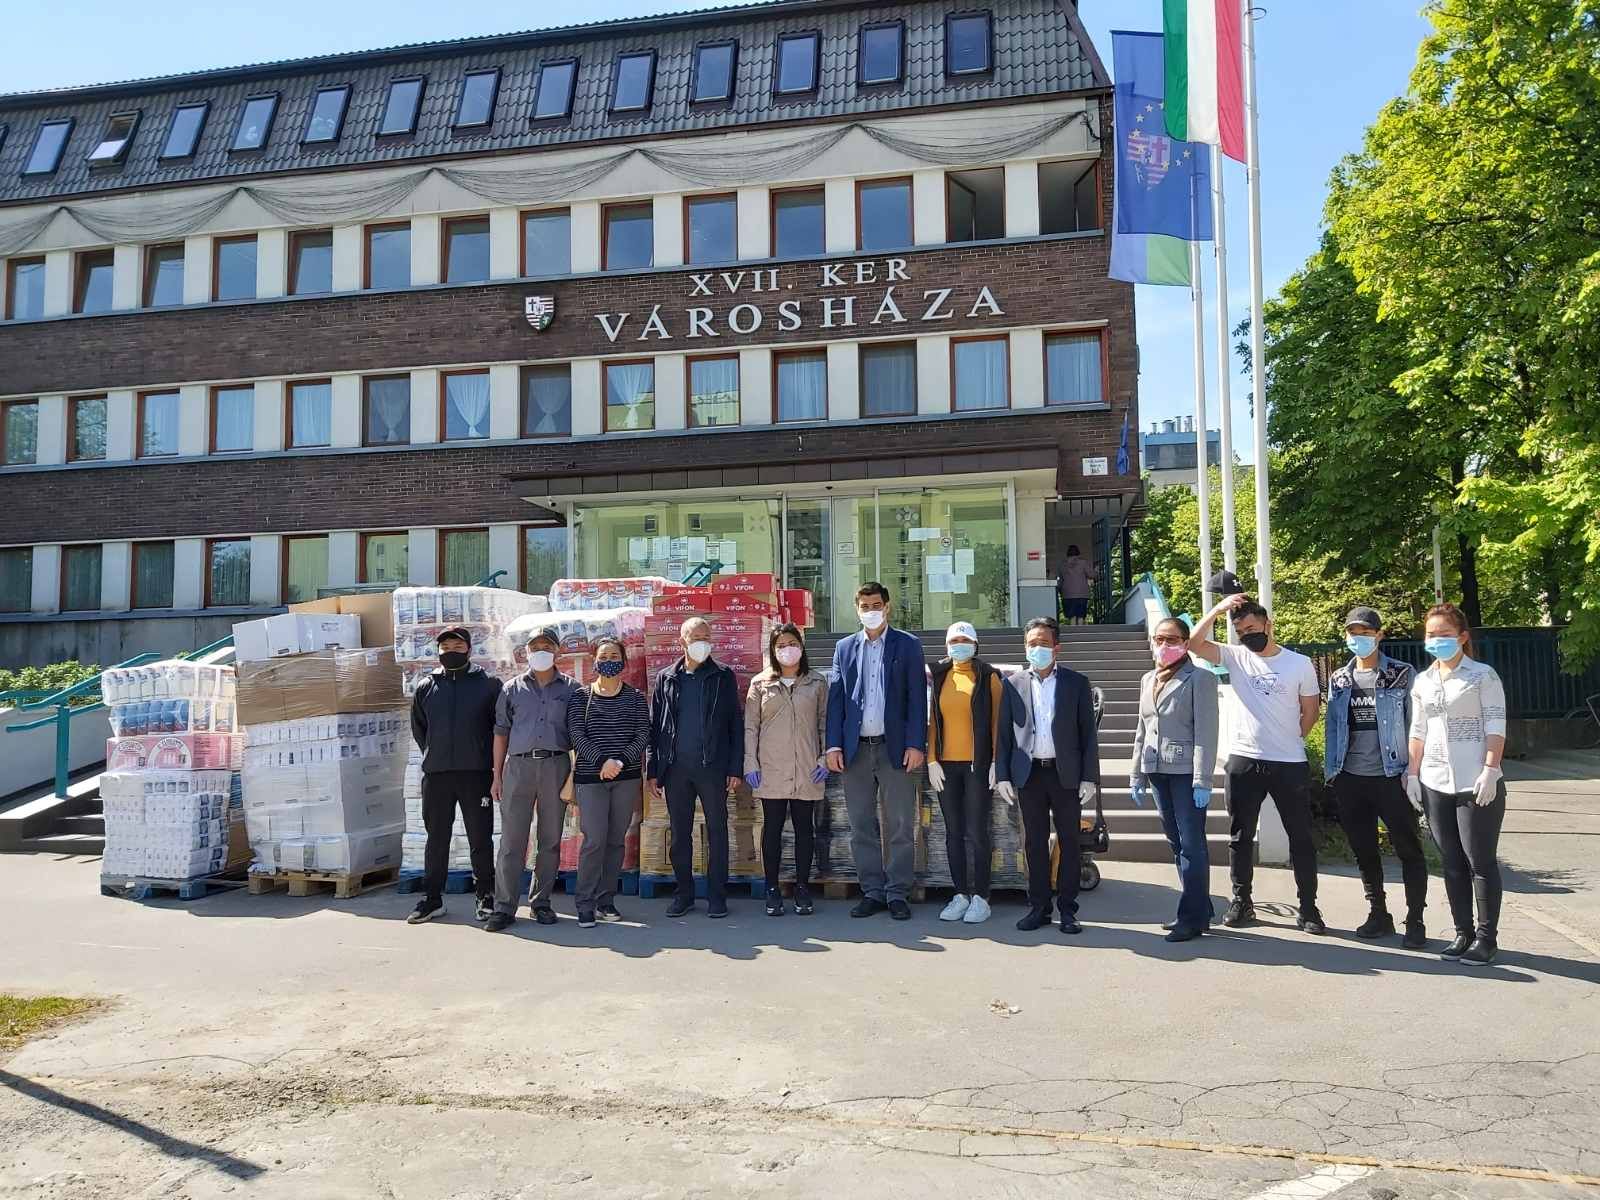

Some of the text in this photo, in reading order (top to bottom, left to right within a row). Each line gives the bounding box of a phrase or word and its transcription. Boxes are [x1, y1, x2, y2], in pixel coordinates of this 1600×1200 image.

[687, 257, 912, 298] XVII. KER
[594, 285, 1006, 343] VÁROSHÁZA
